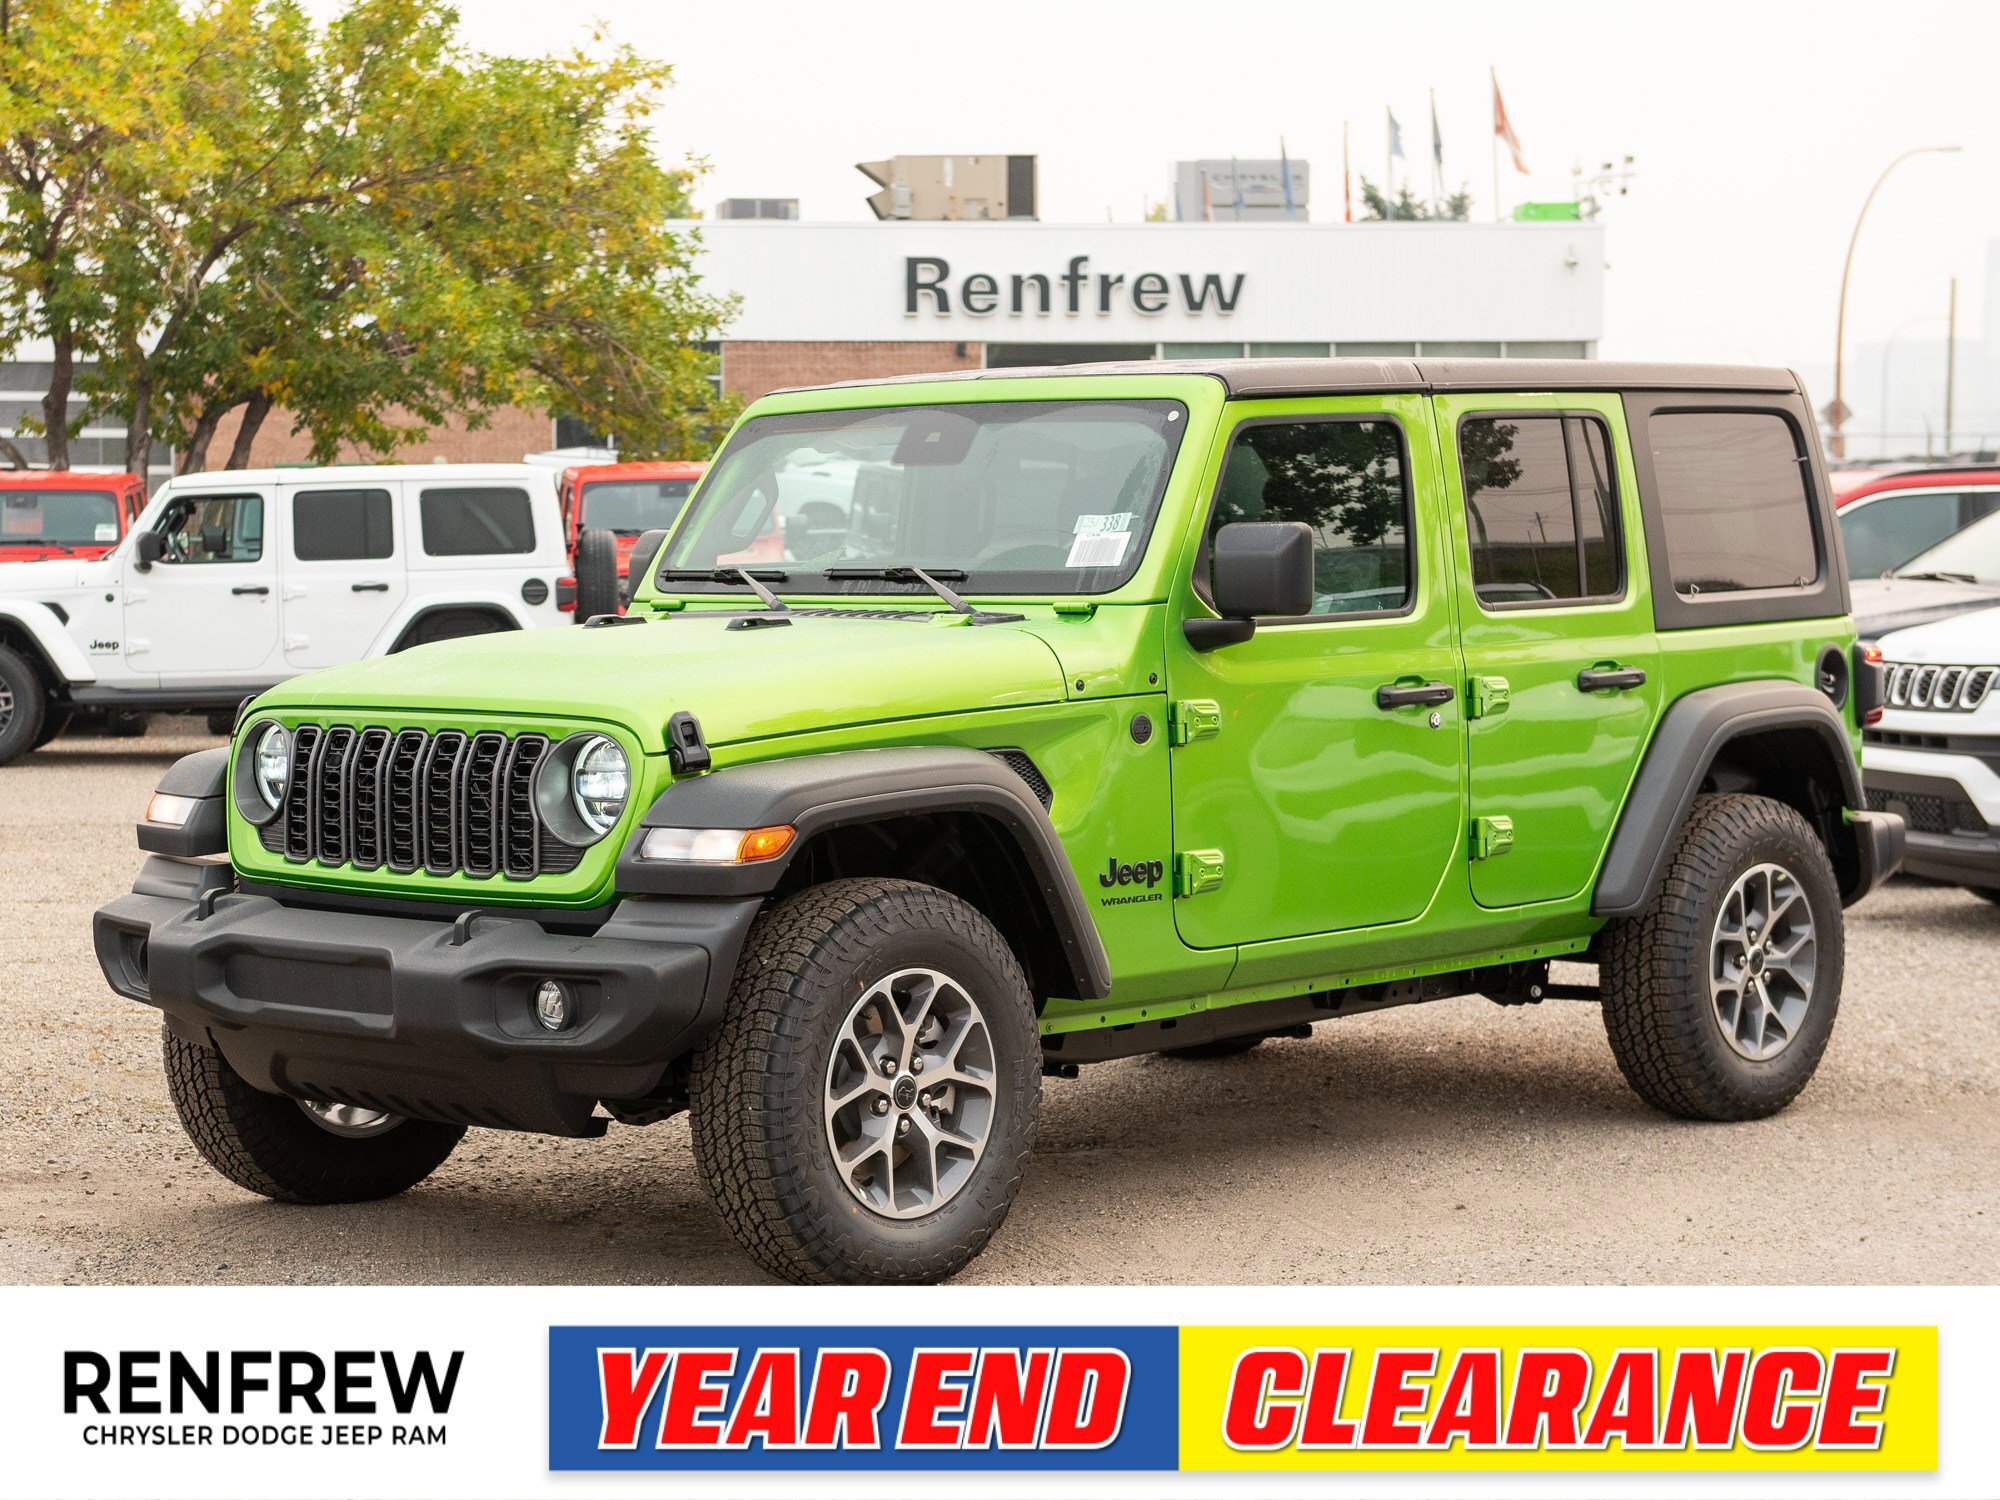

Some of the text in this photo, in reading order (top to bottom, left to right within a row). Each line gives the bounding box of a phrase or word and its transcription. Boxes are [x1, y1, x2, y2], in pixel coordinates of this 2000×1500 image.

[905, 255, 1246, 314] Renfrew
[89, 640, 120, 650] Jeep
[1099, 856, 1163, 888] Jeep
[1100, 893, 1163, 907] WRANGLER
